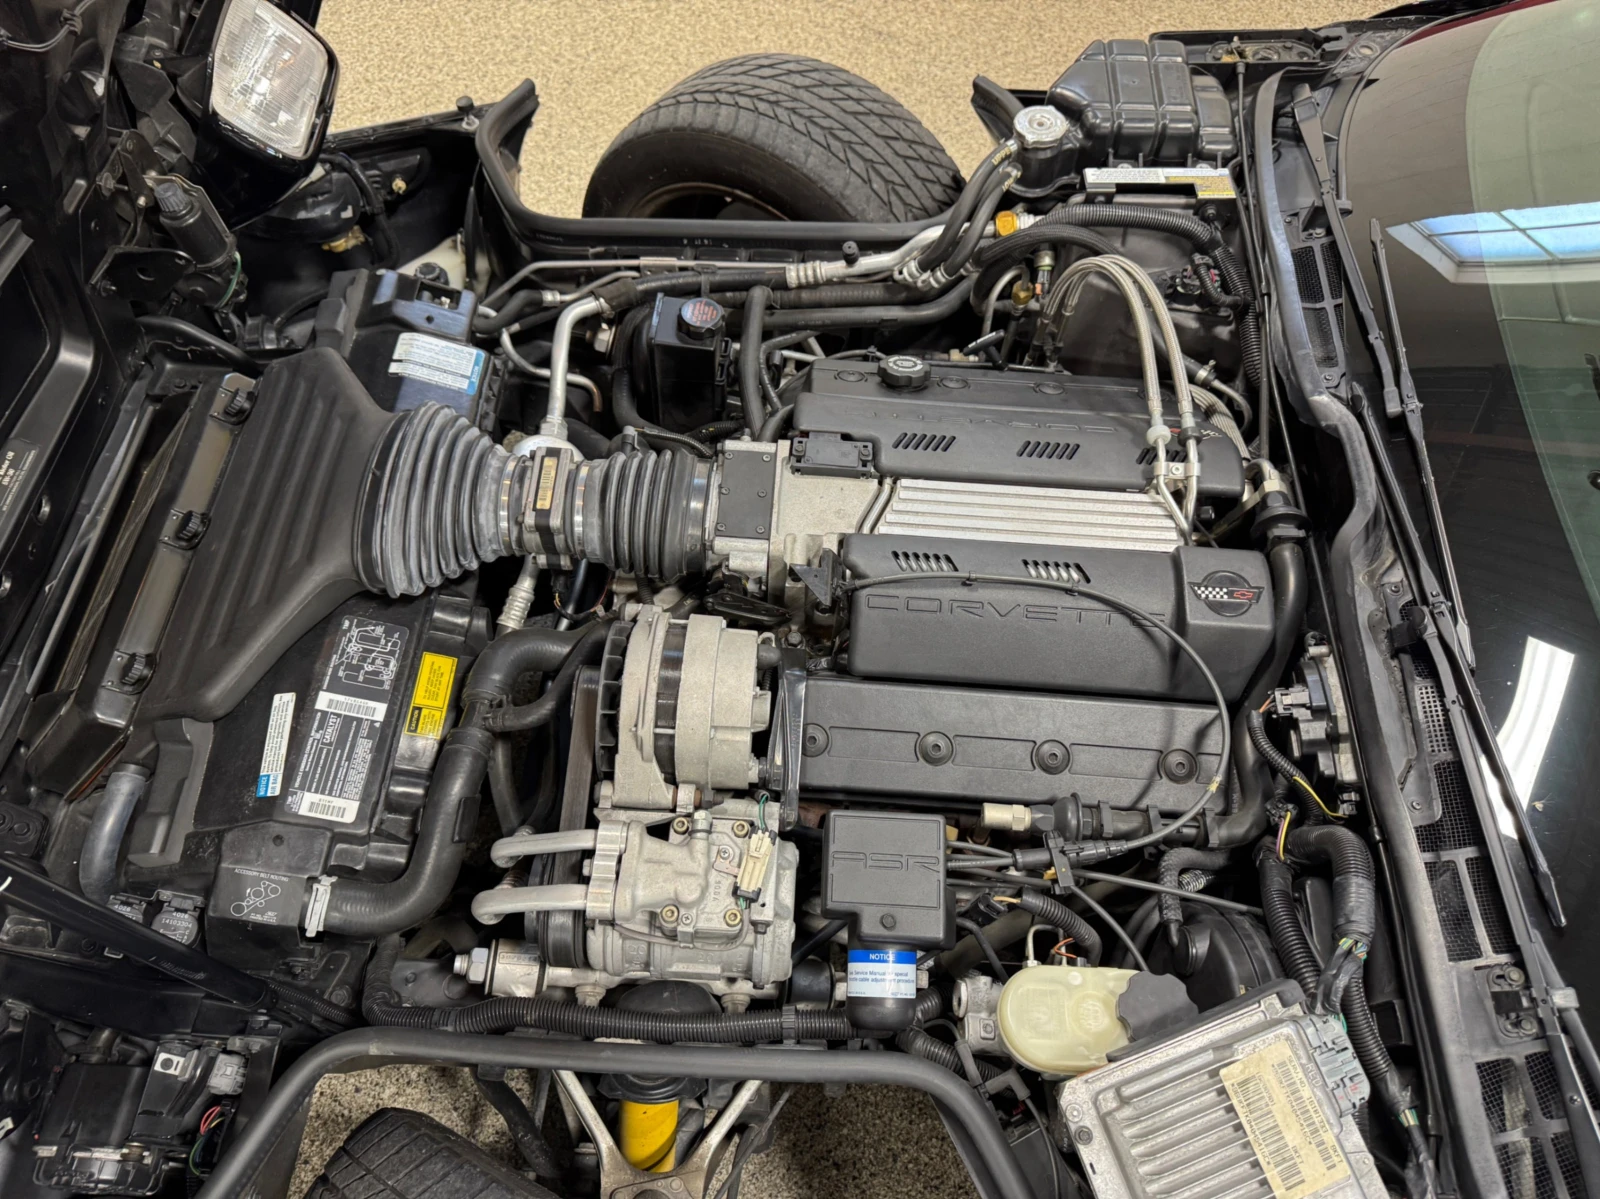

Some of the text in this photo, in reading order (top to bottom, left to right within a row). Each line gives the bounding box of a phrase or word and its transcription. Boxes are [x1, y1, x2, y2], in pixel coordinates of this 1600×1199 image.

[471, 366, 479, 381] NOTICE
[6, 451, 15, 460] Oil
[2, 468, 15, 485] 5W-30
[865, 593, 1165, 628] CORVETTE
[322, 714, 337, 743] CATALYST
[409, 709, 420, 730] CAUTION
[293, 772, 303, 787] VEHICLE
[298, 754, 308, 771] EMISSION
[304, 737, 313, 753] CONTROL
[309, 711, 321, 736] INFORMATION
[259, 776, 267, 794] NOTICE
[270, 775, 278, 783] BAG
[831, 851, 940, 873] ASR
[234, 868, 260, 877] ACCESSORY
[161, 918, 193, 928] 14103304
[1291, 1145, 1304, 1164] BKFT
[1330, 1144, 1344, 1164] BKFT
